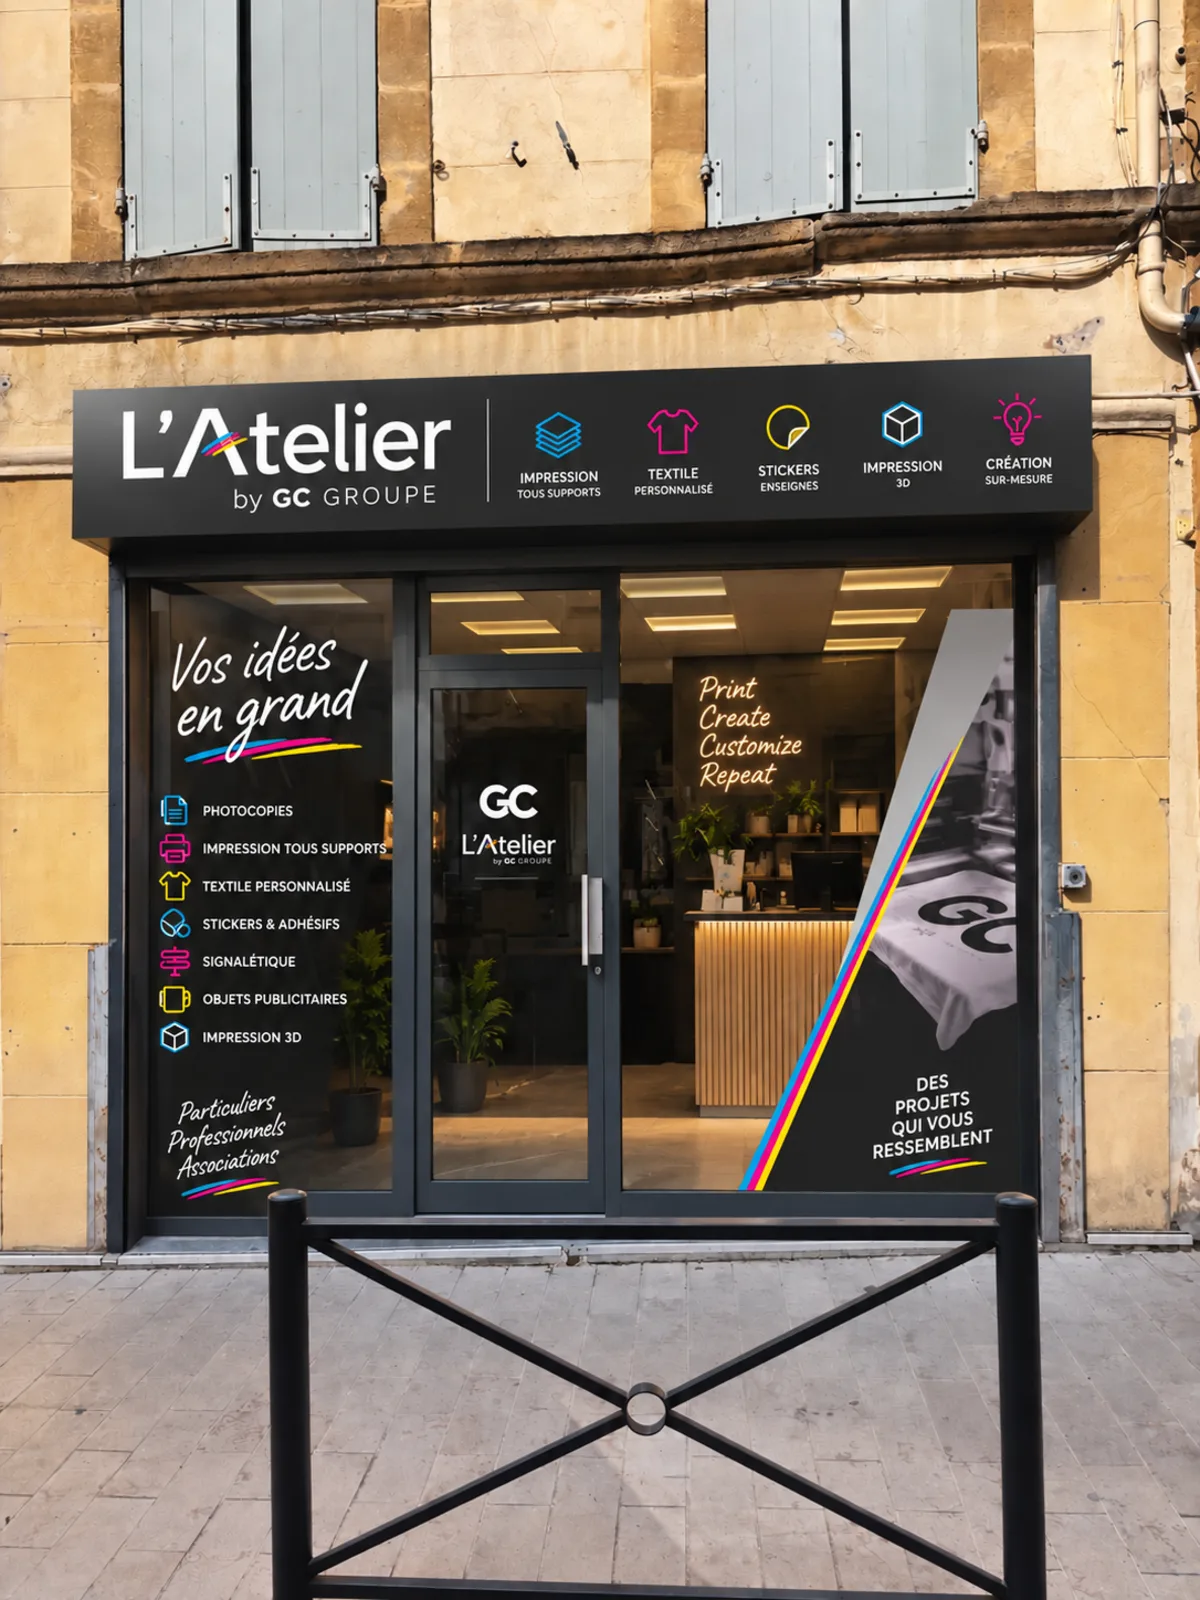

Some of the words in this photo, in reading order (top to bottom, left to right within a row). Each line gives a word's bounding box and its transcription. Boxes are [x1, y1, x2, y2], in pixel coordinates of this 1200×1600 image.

[122, 402, 452, 480] L'Atelier
[758, 463, 820, 477] STICKERS
[863, 460, 943, 474] IMPRESSION
[985, 454, 1052, 470] CRÉATION
[520, 470, 599, 484] IMPRESSION
[647, 467, 699, 481] TEXTILE
[985, 473, 1053, 485] SUR-MESURE
[634, 482, 714, 496] PERSONNALISÉ
[760, 480, 819, 492] ENSEIGNES
[896, 477, 911, 488] 3D
[233, 488, 263, 514] by
[272, 487, 311, 509] GC
[323, 484, 437, 507] GROUPE
[517, 488, 545, 499] TOUS
[547, 486, 601, 499] SUPPORTS
[172, 636, 232, 692] Vos
[243, 625, 337, 682] idées
[699, 676, 757, 701] Print
[177, 705, 223, 736] en
[225, 659, 369, 763] grand
[699, 704, 771, 730] Create
[699, 733, 802, 758] Customize
[699, 762, 777, 792] Repeat
[479, 783, 539, 819] GC
[203, 805, 293, 817] PHOTOCOPIES
[203, 842, 281, 855] IMPRESSION
[284, 842, 318, 855] TOUS
[321, 842, 387, 855] SUPPORTS
[462, 833, 557, 855] L'Atelier
[493, 858, 502, 866] by
[203, 880, 252, 892] TEXTILE
[255, 877, 351, 892] PERSONNALISÉ
[203, 918, 263, 930] STICKERS
[265, 918, 275, 930] &
[278, 915, 340, 930] ADHÉSIFS
[202, 953, 296, 969] SIGNALÉTIQUE
[202, 993, 251, 1005] OBJETS
[254, 993, 348, 1005] PUBLICITAIRES
[203, 1031, 281, 1043] IMPRESSION
[284, 1031, 302, 1043] 3D
[916, 1073, 949, 1092] DES
[178, 1090, 276, 1125] Particuliers
[895, 1091, 970, 1115] PROJETS
[891, 1117, 922, 1137] QUI
[926, 1111, 973, 1131] VOUS
[168, 1112, 287, 1155] Professionnels
[872, 1128, 993, 1159] RESSEMBLENT
[177, 1149, 280, 1180] Associations
